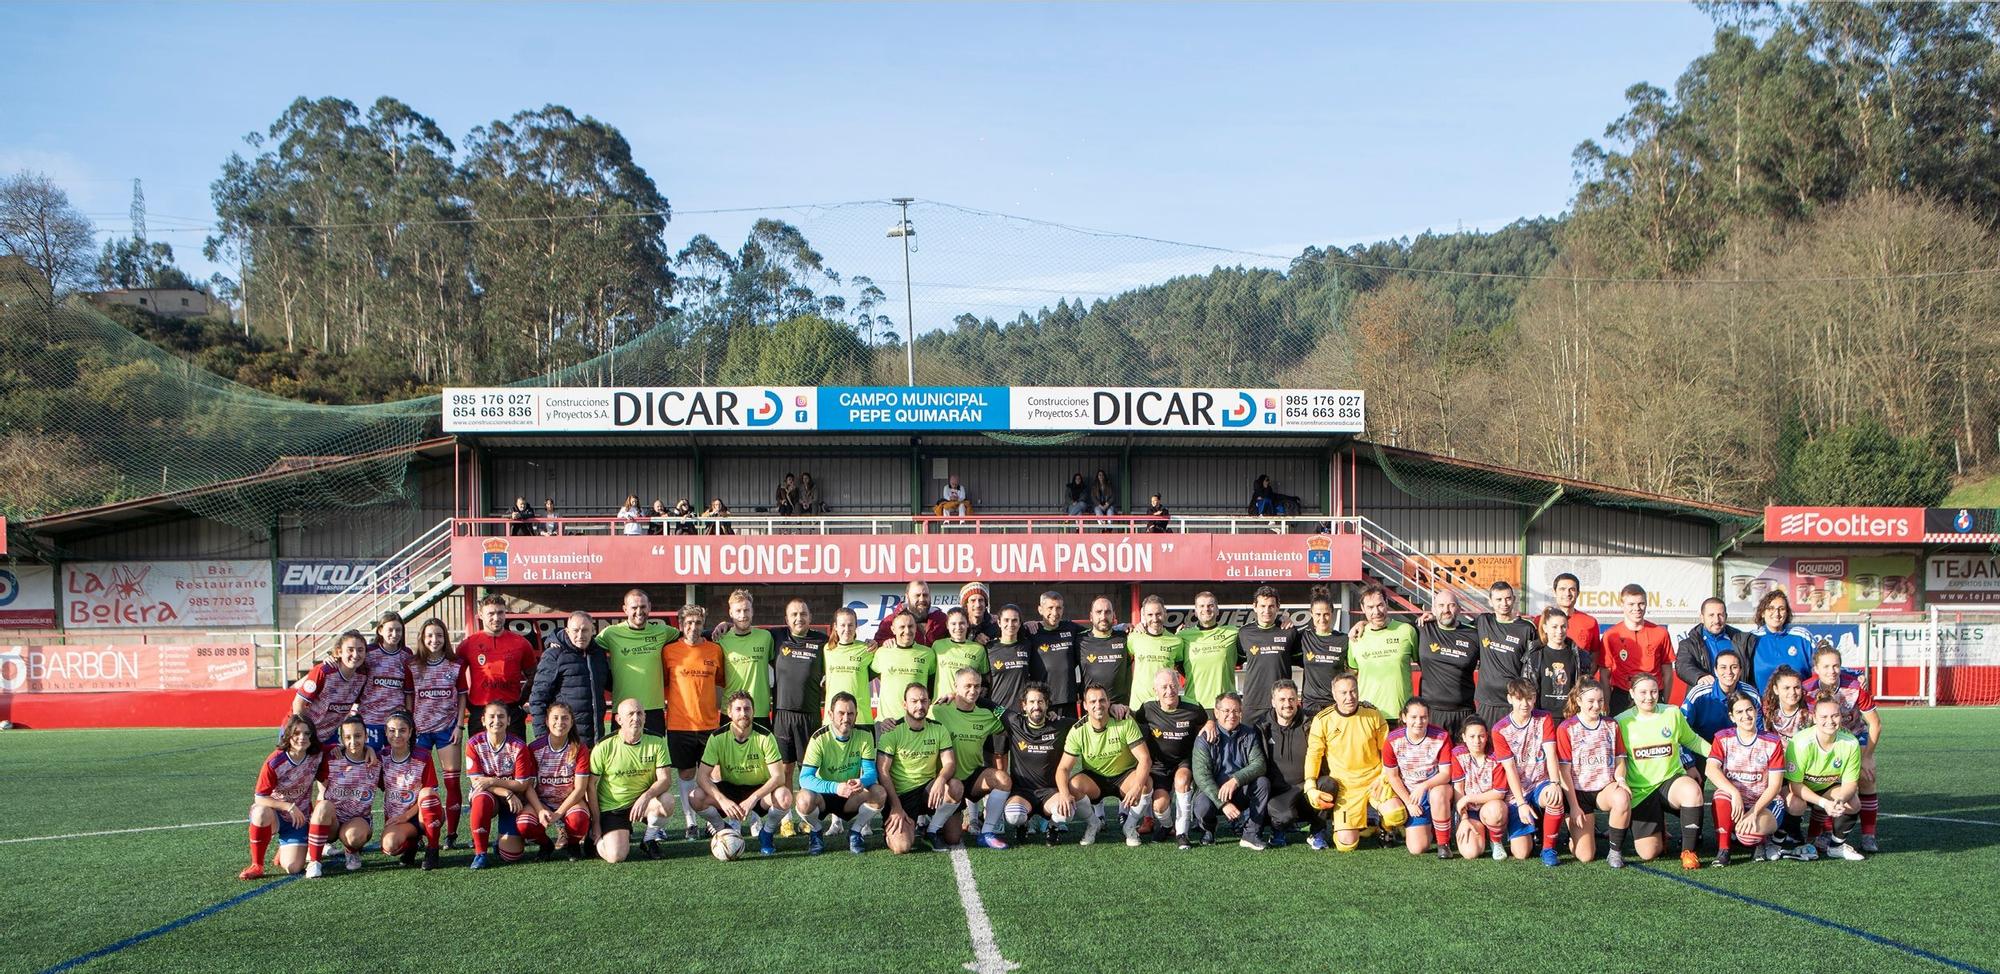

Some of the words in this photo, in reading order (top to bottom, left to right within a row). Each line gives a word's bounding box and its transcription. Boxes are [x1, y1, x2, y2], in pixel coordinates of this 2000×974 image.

[453, 395, 476, 404] 985
[482, 395, 504, 404] 176
[508, 395, 531, 404] 027
[546, 397, 609, 406] Construcciones
[840, 392, 898, 406] CAMPO
[902, 393, 988, 406] MUNICIPAL
[1028, 396, 1089, 406] Construcciones
[1286, 396, 1308, 405] 985
[1314, 396, 1334, 405] 176
[1338, 396, 1361, 405] 027
[453, 407, 476, 417] 654
[480, 407, 504, 417] 663
[508, 407, 532, 417] 836
[614, 392, 740, 426] DICAR
[1028, 410, 1033, 420] y
[1034, 408, 1073, 420] Proyectos
[1074, 408, 1090, 418] S.A.
[1094, 391, 1215, 426] DICAR
[1286, 408, 1308, 418] 654
[1312, 408, 1334, 418] 663
[1338, 408, 1361, 418] 836
[546, 412, 551, 421] y
[553, 410, 592, 421] Proyectos
[594, 409, 609, 418] S.A.
[850, 409, 890, 422] PEPE
[895, 406, 982, 423] QUIMARÁN
[1804, 512, 1909, 536] Footters
[512, 552, 603, 566] Ayuntamiento
[674, 544, 710, 575] UN
[720, 544, 851, 578] CONCEJO,
[860, 544, 896, 574] UN
[904, 543, 982, 577] CLUB,
[991, 544, 1046, 573] UNA
[1054, 536, 1152, 572] PASIÓN
[1216, 550, 1303, 564] Ayuntamiento
[208, 566, 233, 575] Bar
[523, 568, 538, 580] de
[542, 568, 592, 580] Llanera
[1226, 566, 1240, 576] de
[1245, 566, 1292, 576] Llanera
[1799, 564, 1840, 573] OQUENDO
[69, 571, 105, 594] La
[176, 580, 267, 590] Restaurante
[189, 597, 210, 606] 985
[212, 597, 232, 606] 770
[234, 596, 255, 606] 923
[70, 599, 178, 624] Bolera
[196, 648, 212, 657] 985
[214, 648, 224, 657] 08
[227, 648, 237, 657] 09
[239, 647, 250, 656] 08
[30, 645, 138, 680] BARBÓN
[420, 690, 451, 698] OQUENDO
[1636, 746, 1671, 757] OQUENDO
[1726, 771, 1762, 780] OQUENDO
